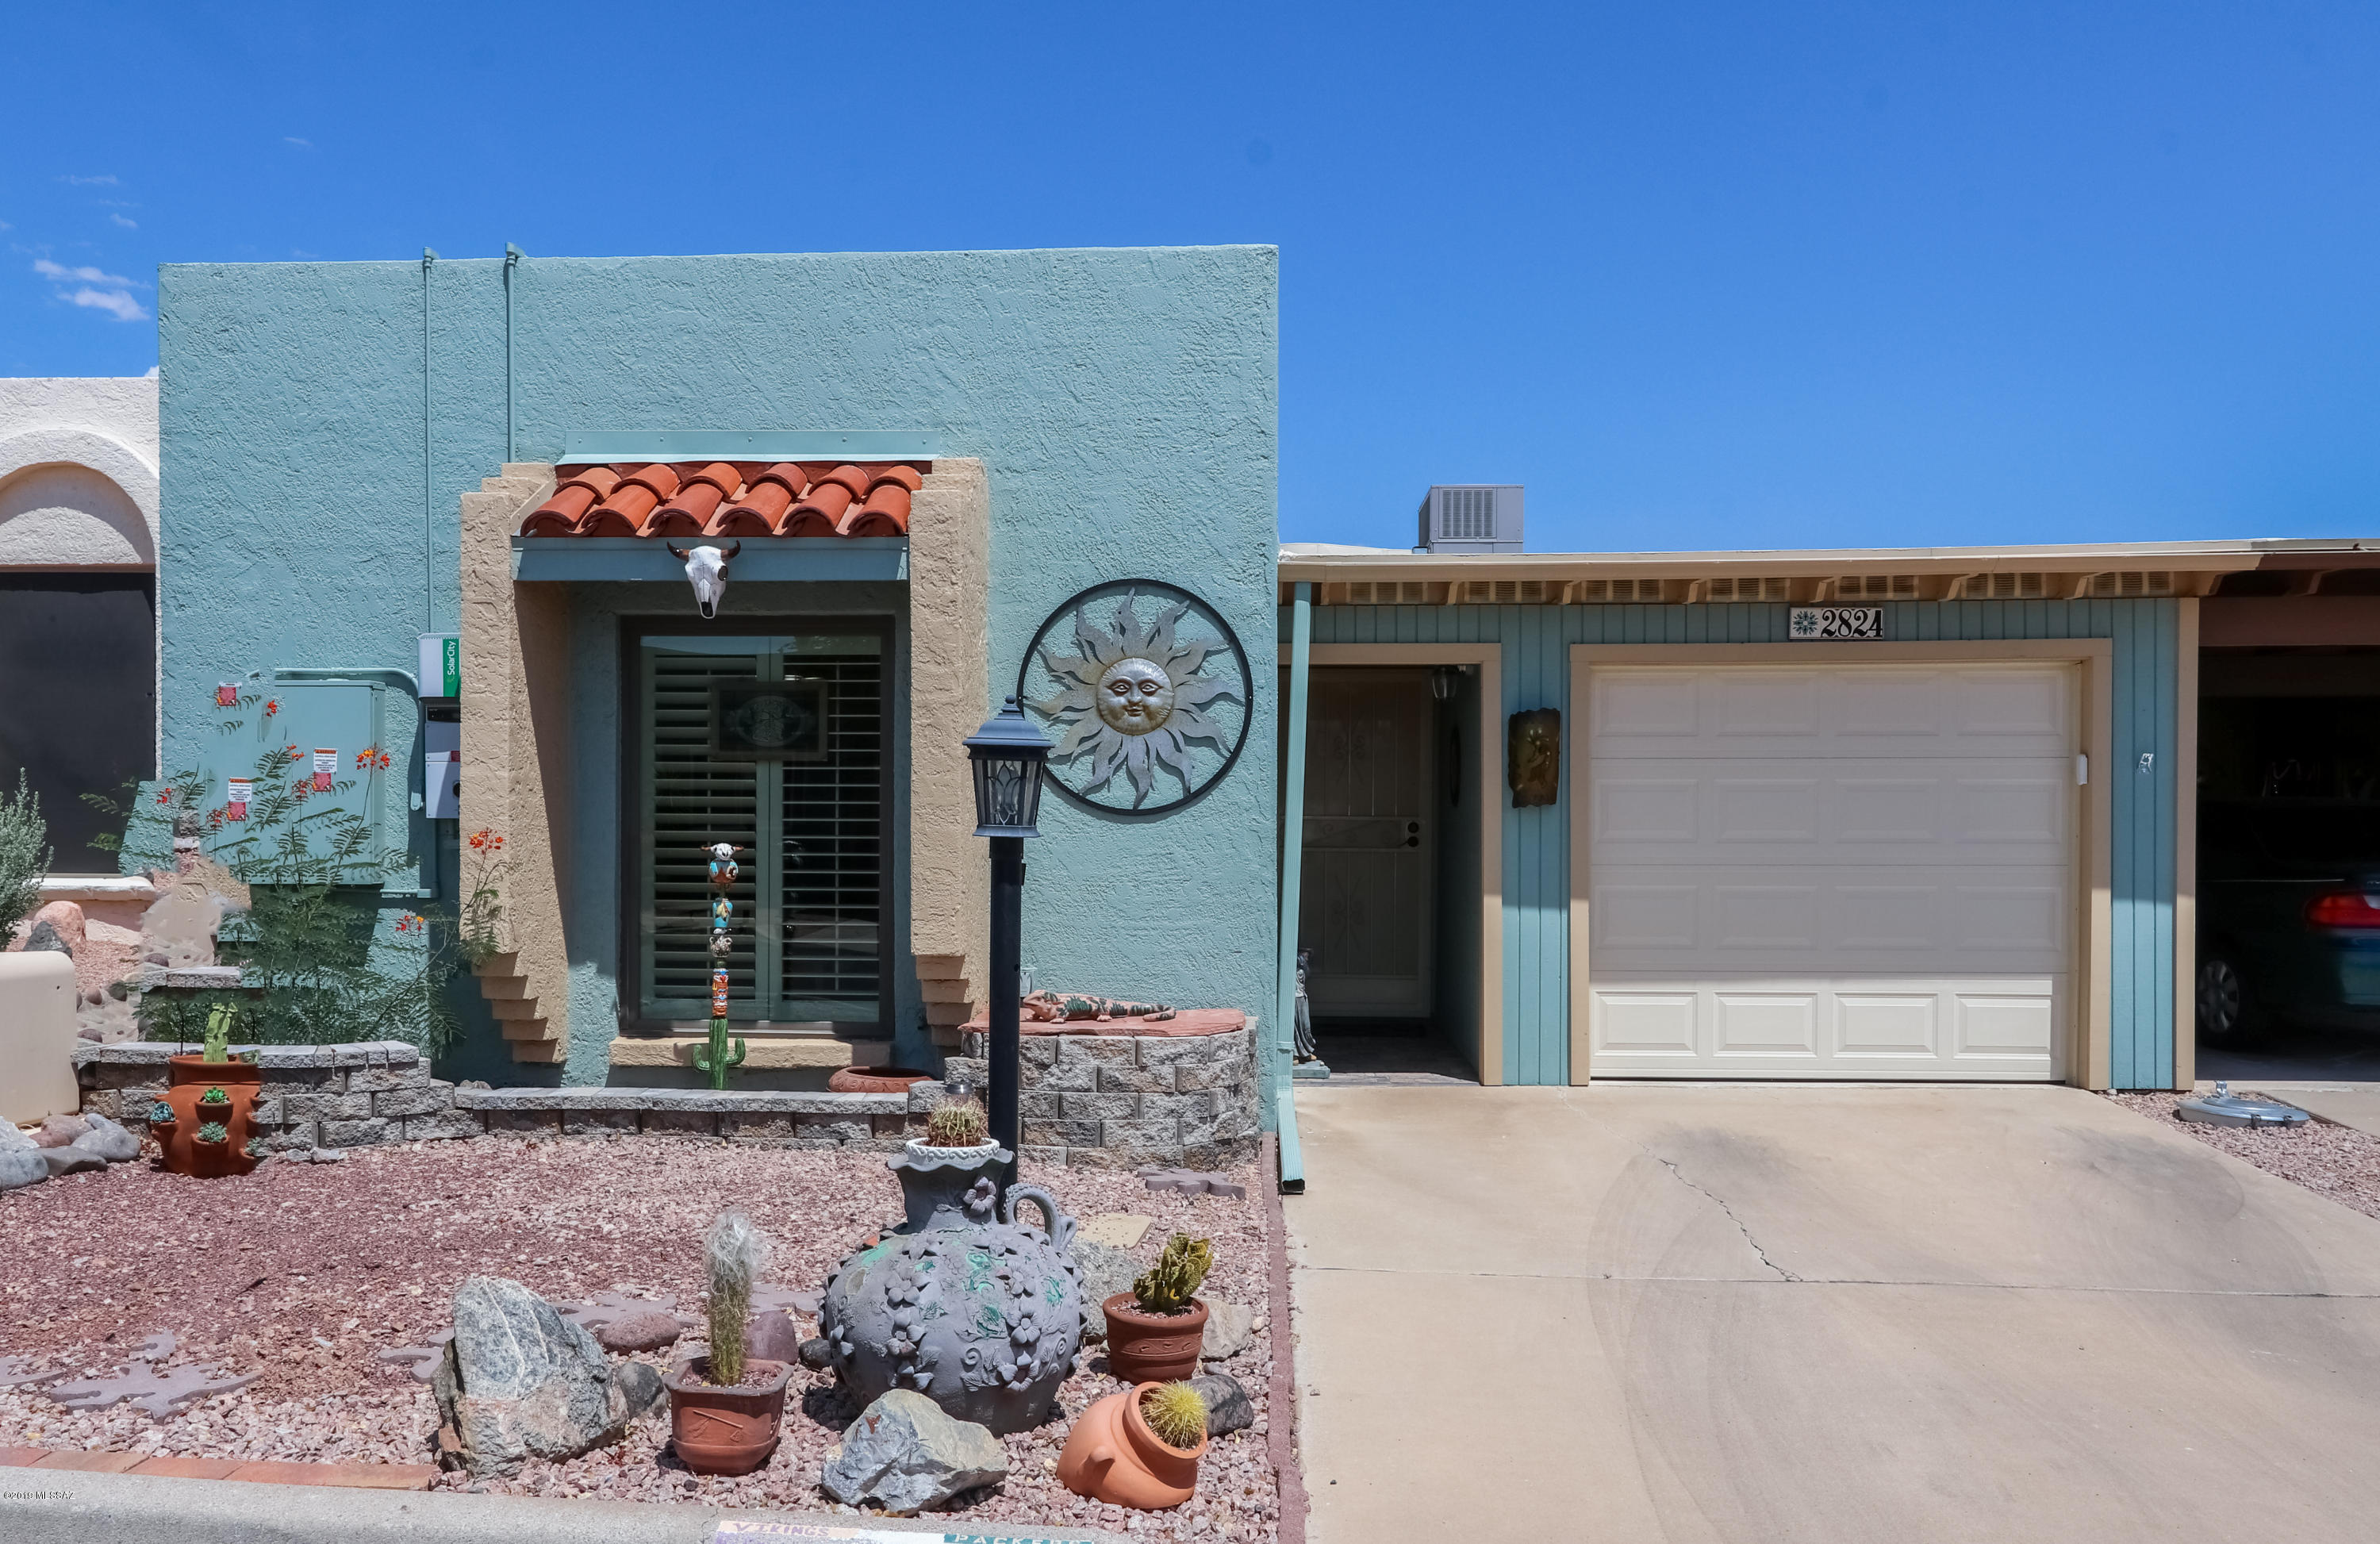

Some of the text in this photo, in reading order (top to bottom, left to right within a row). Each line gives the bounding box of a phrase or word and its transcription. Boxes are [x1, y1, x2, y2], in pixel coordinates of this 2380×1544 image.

[1821, 609, 1883, 638] 2824
[447, 640, 457, 676] SolarCity
[732, 1523, 829, 1537] VIKINGS
